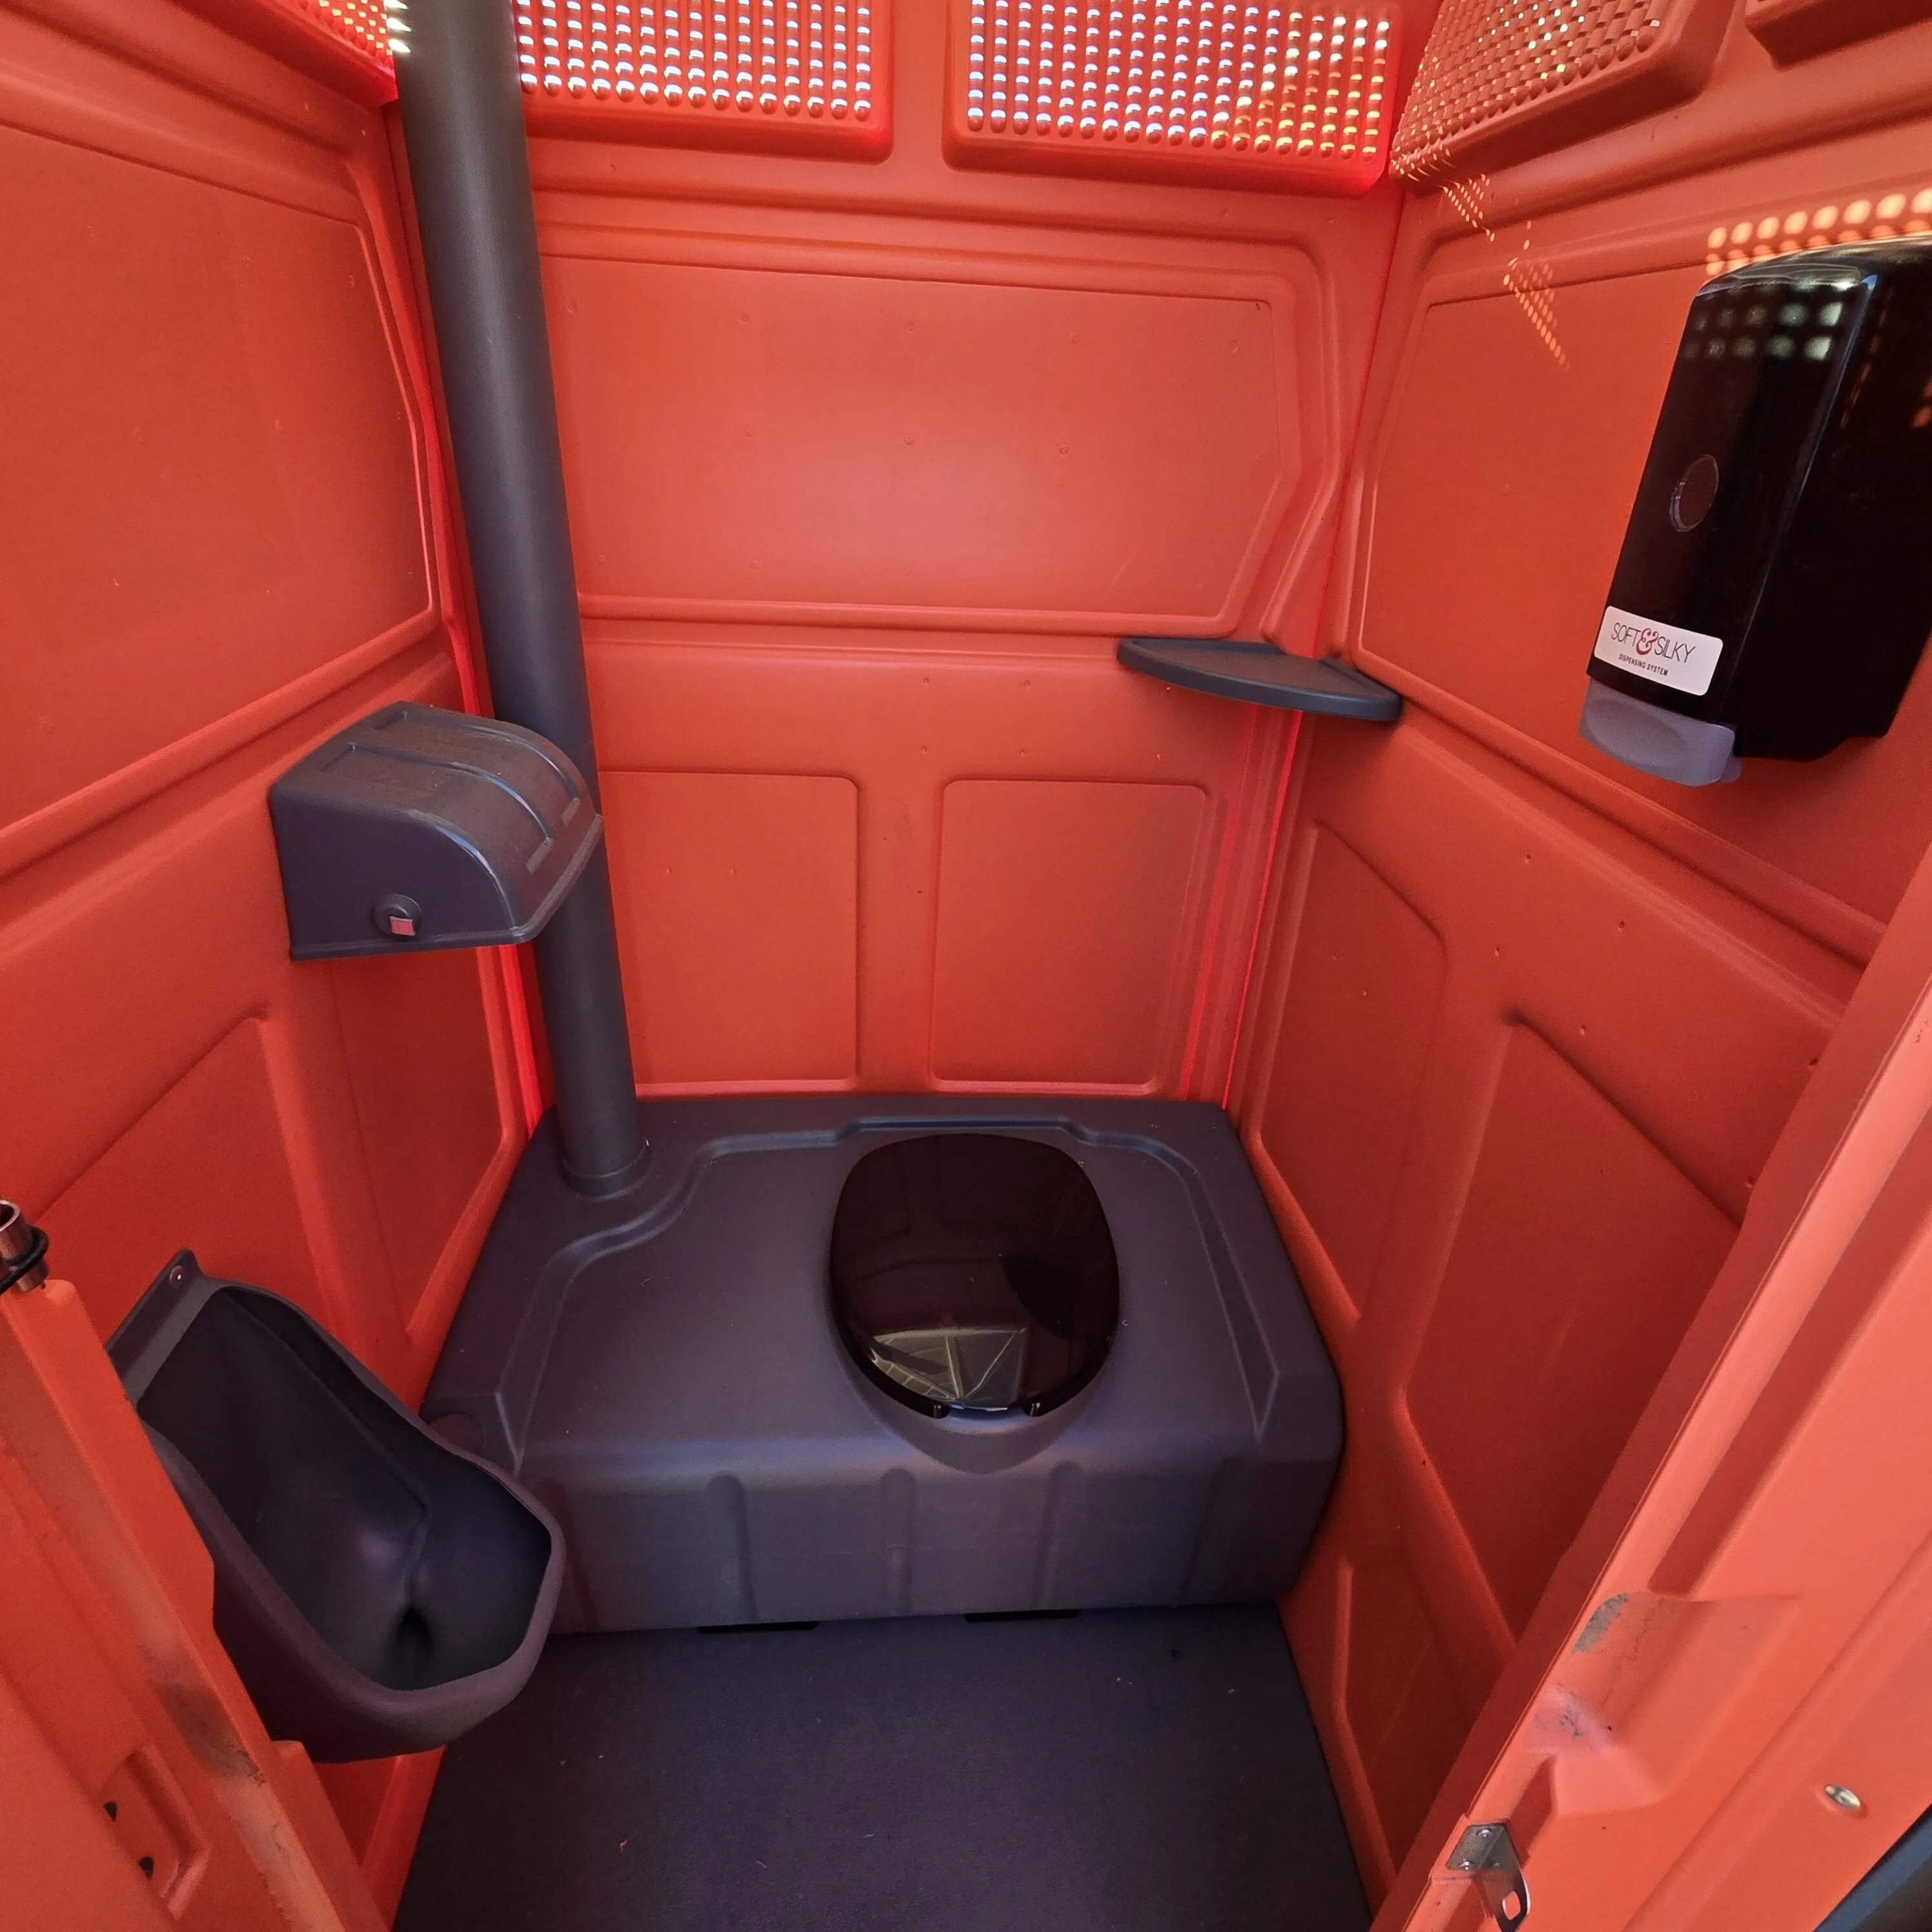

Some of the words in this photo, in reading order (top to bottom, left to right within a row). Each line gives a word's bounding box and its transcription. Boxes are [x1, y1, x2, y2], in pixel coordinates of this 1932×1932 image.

[1611, 622, 1641, 647] SOFT
[1636, 628, 1659, 655] &
[1654, 636, 1696, 663] SILKY
[1618, 653, 1646, 669] DISPENSING
[1646, 663, 1669, 676] SYSTEM
